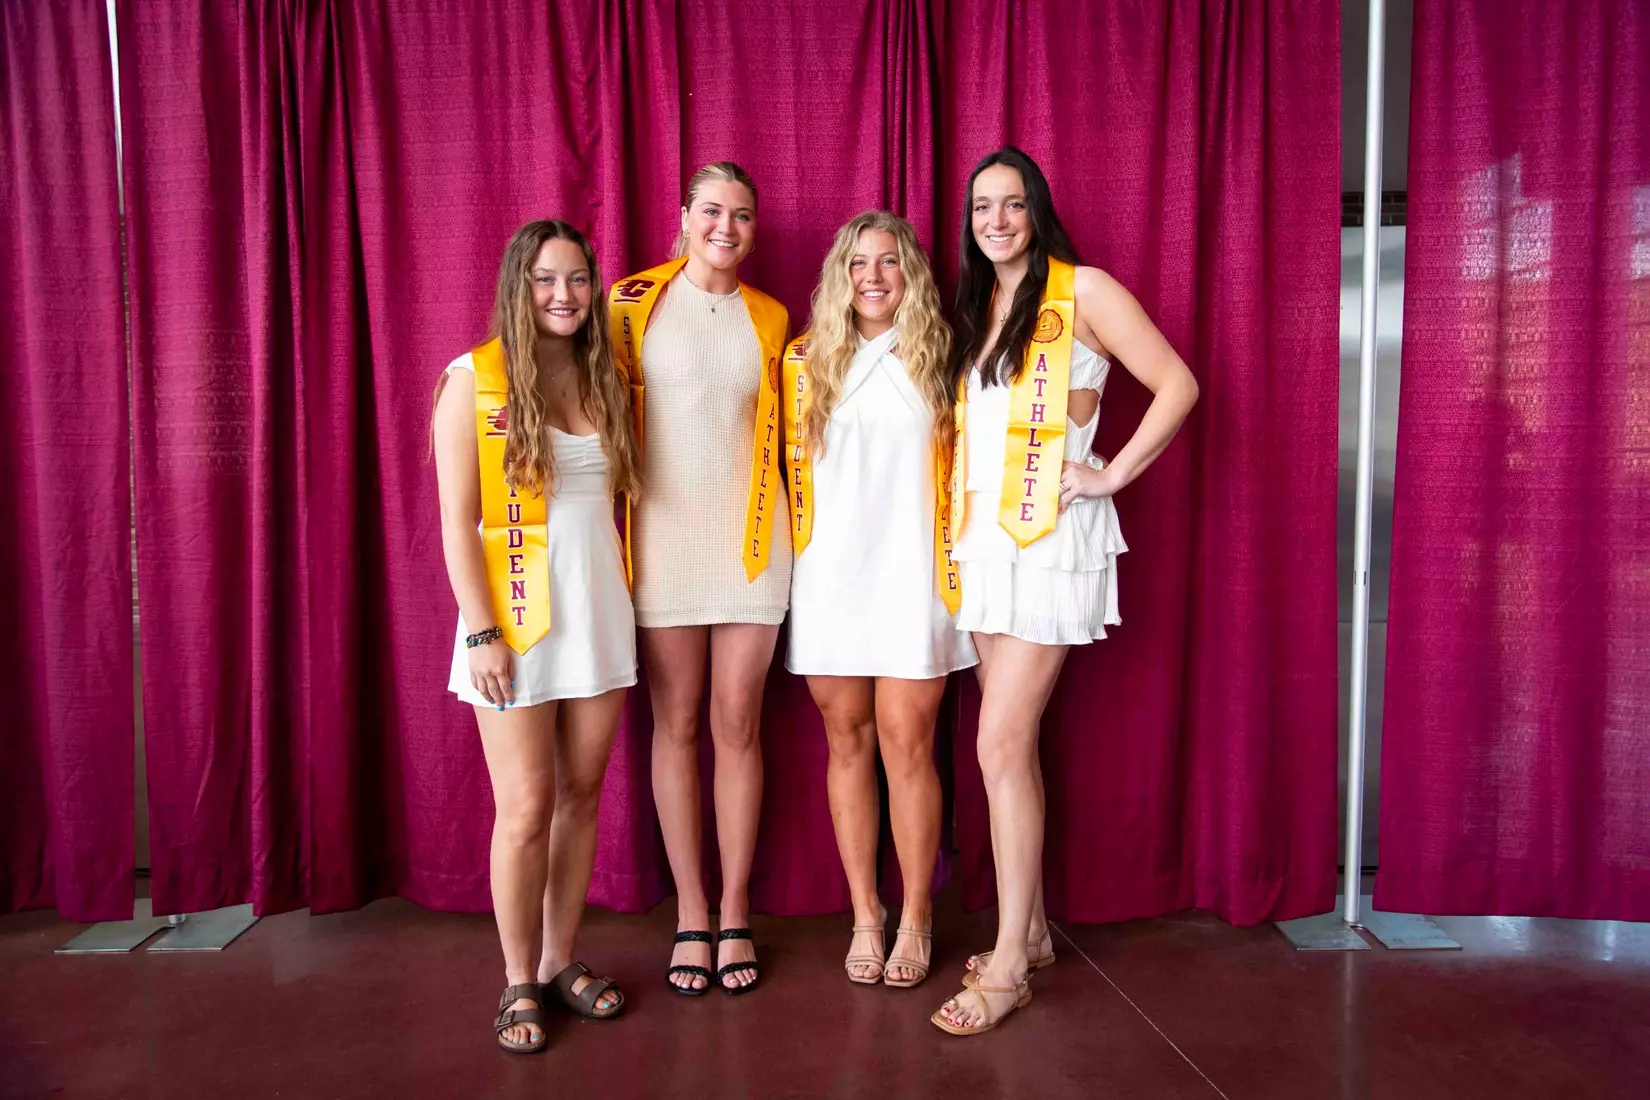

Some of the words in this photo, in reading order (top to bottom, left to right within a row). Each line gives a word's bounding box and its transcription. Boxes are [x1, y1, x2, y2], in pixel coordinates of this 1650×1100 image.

[753, 402, 776, 558] ATHLETE
[793, 374, 805, 532] STUDENT
[1019, 352, 1048, 522] ATHLETE
